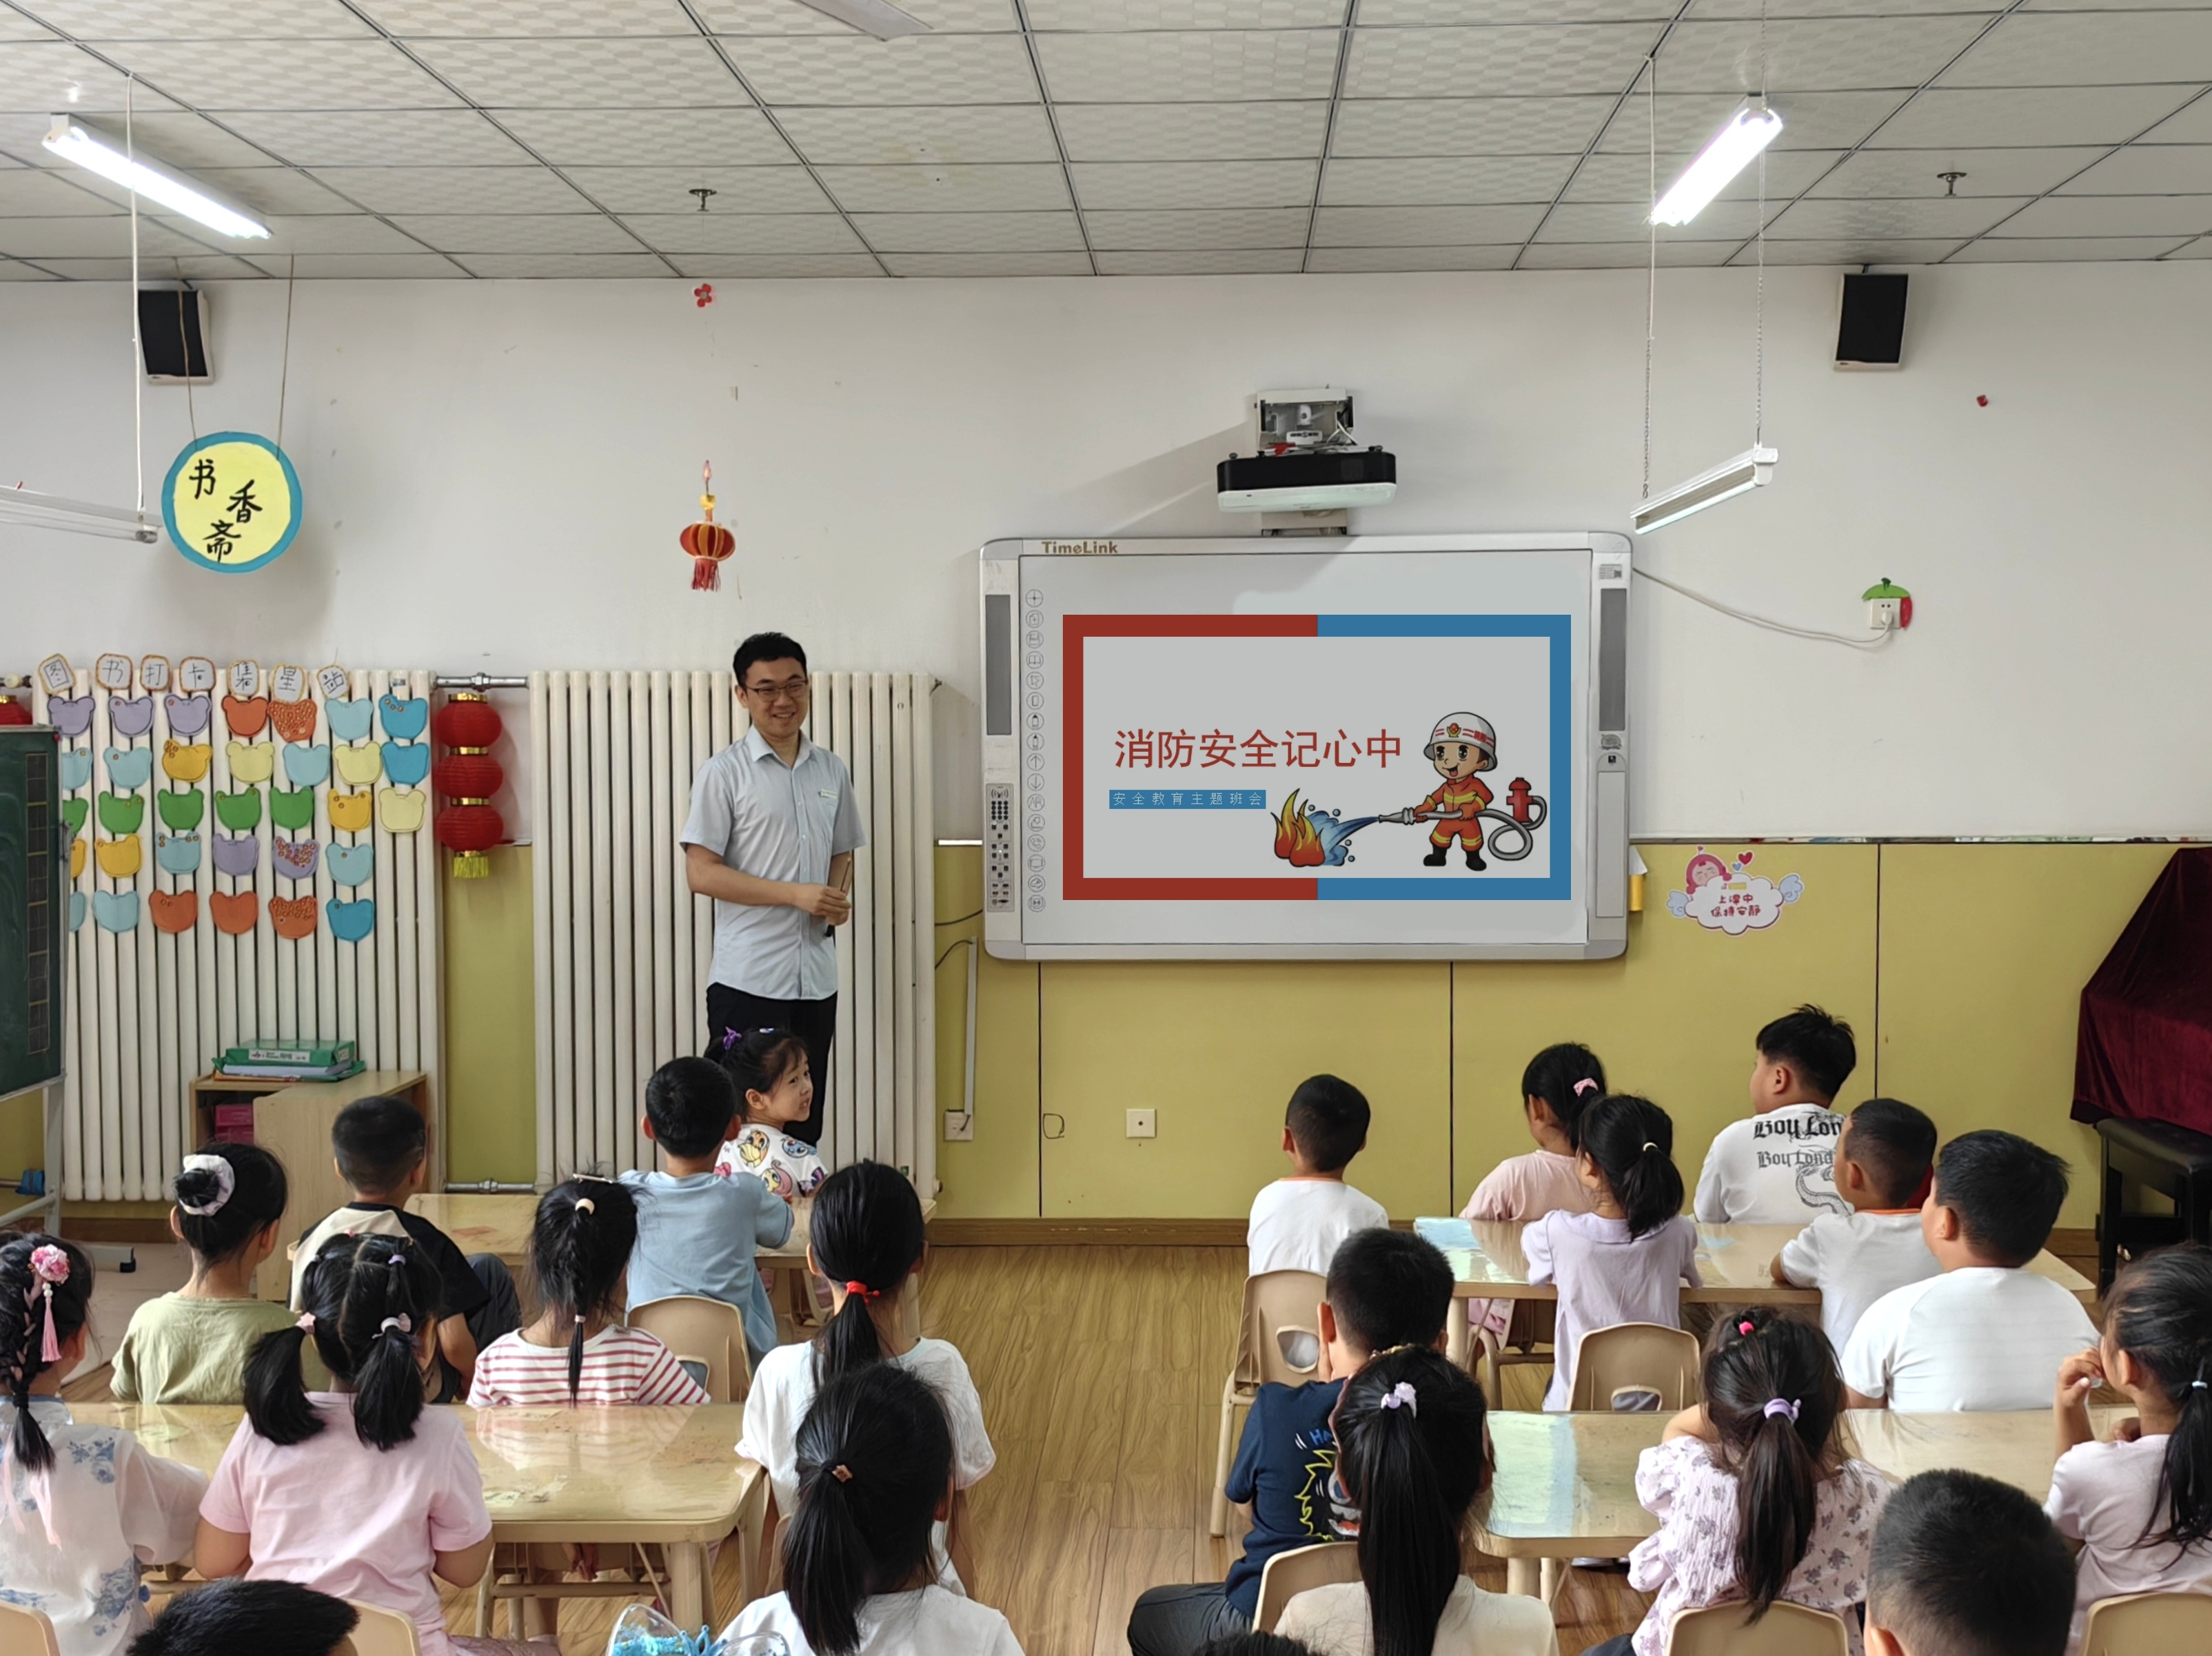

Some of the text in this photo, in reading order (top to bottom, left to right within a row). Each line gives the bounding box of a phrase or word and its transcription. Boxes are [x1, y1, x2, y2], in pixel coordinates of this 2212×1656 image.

[189, 459, 263, 563] 书香斋
[1042, 541, 1118, 553] TimeLink
[1115, 728, 1401, 768] 消防安全记心中
[1113, 792, 1262, 806] 安全教育主题班会
[1756, 1150, 1792, 1169] Boy
